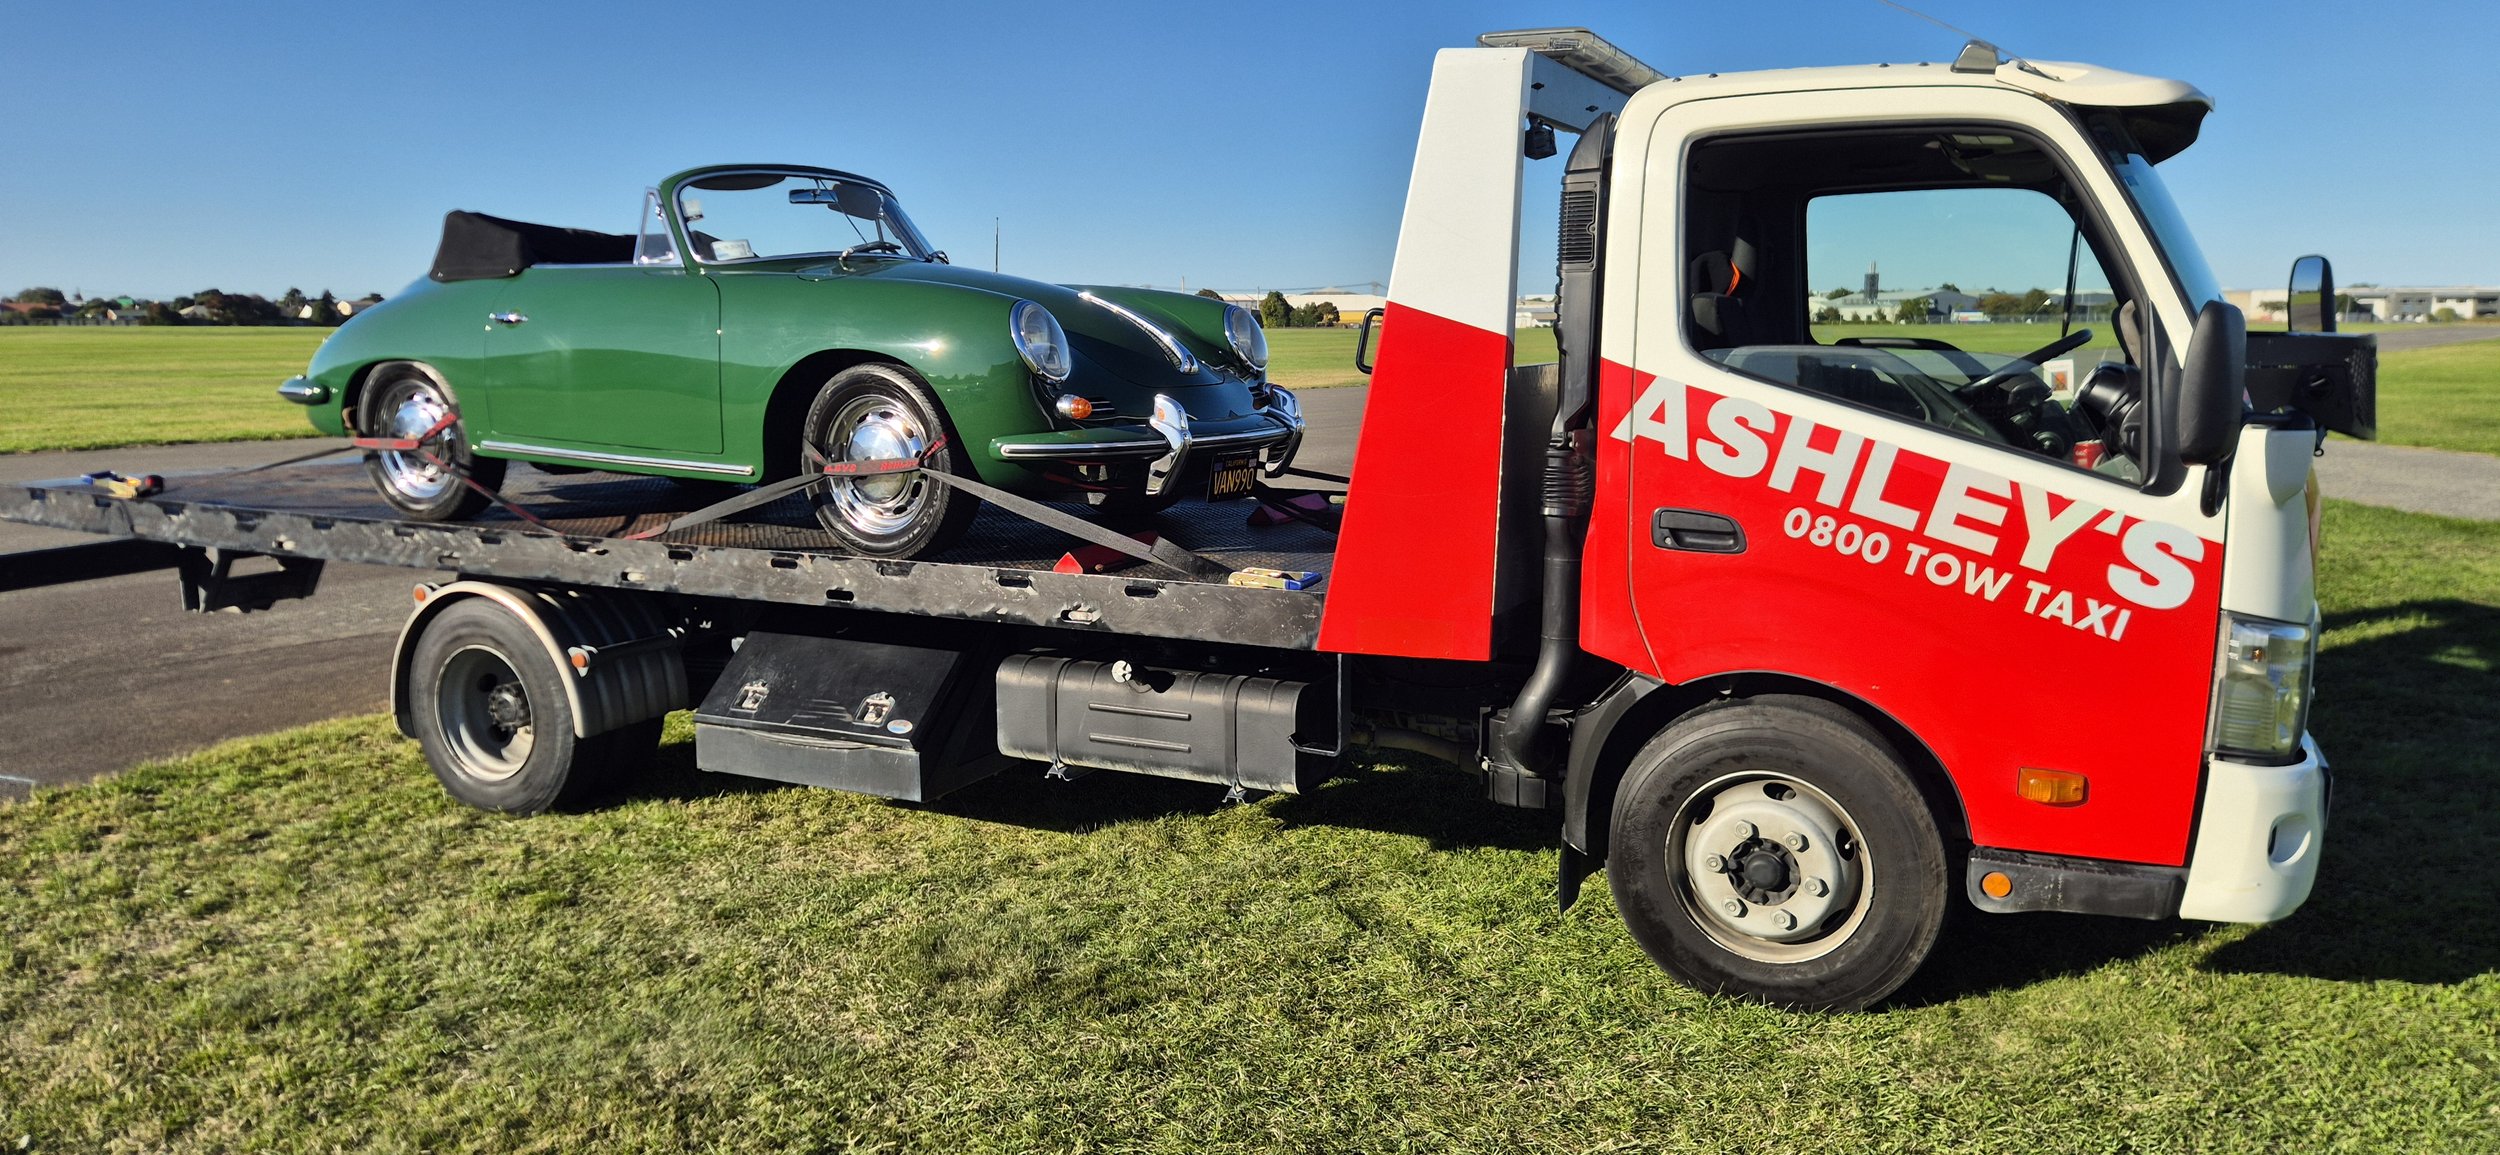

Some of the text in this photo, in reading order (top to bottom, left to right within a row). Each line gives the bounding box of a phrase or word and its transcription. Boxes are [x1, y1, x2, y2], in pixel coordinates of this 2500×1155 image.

[1214, 468, 1254, 494] VAN990
[1610, 376, 2204, 609] ASHLEY'S
[1783, 507, 2131, 642] 0800 TOW TAXI
